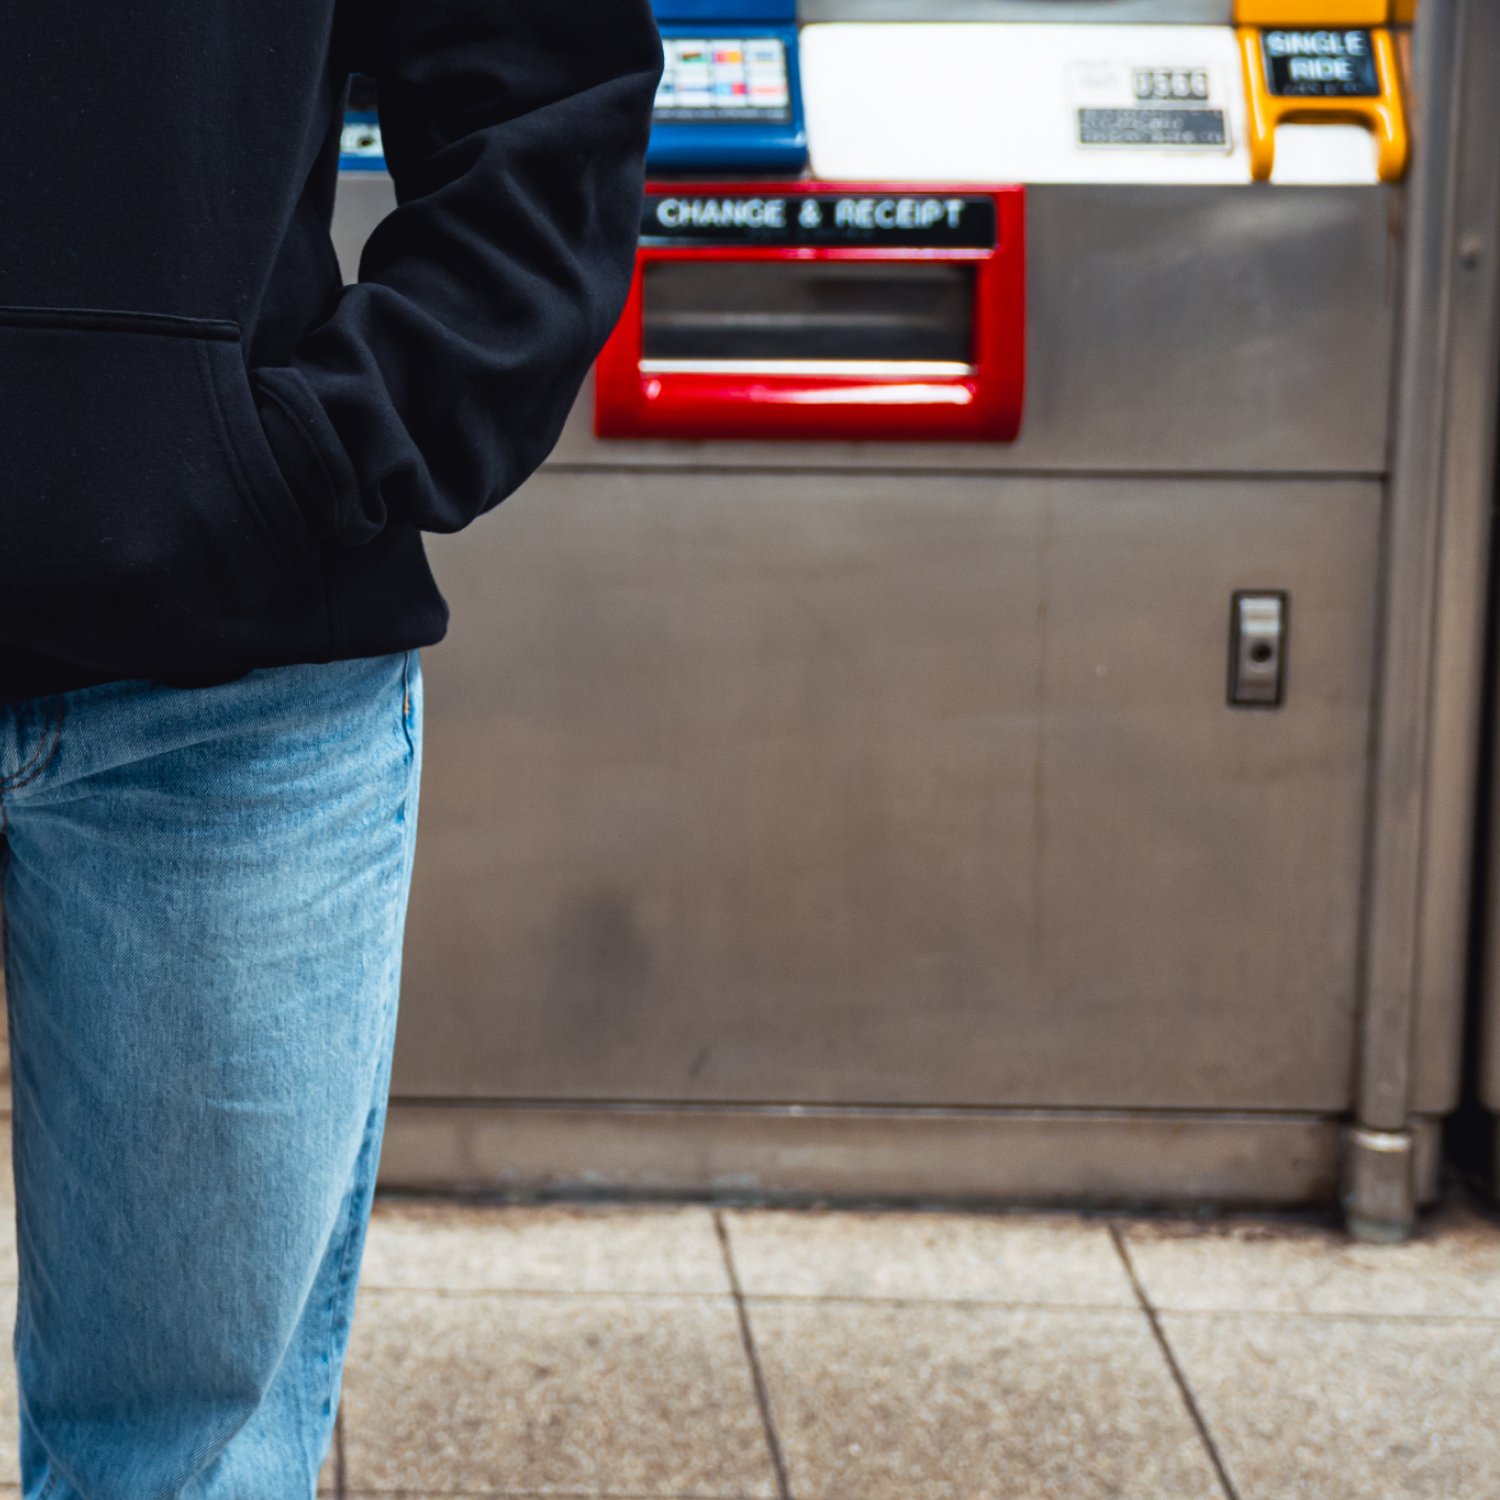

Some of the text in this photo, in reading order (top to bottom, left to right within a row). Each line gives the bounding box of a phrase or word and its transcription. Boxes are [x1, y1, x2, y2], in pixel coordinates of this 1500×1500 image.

[1266, 30, 1366, 57] SINGLE
[1290, 56, 1355, 81] RIDE
[656, 198, 966, 228] CHANGE & RECEIPT
